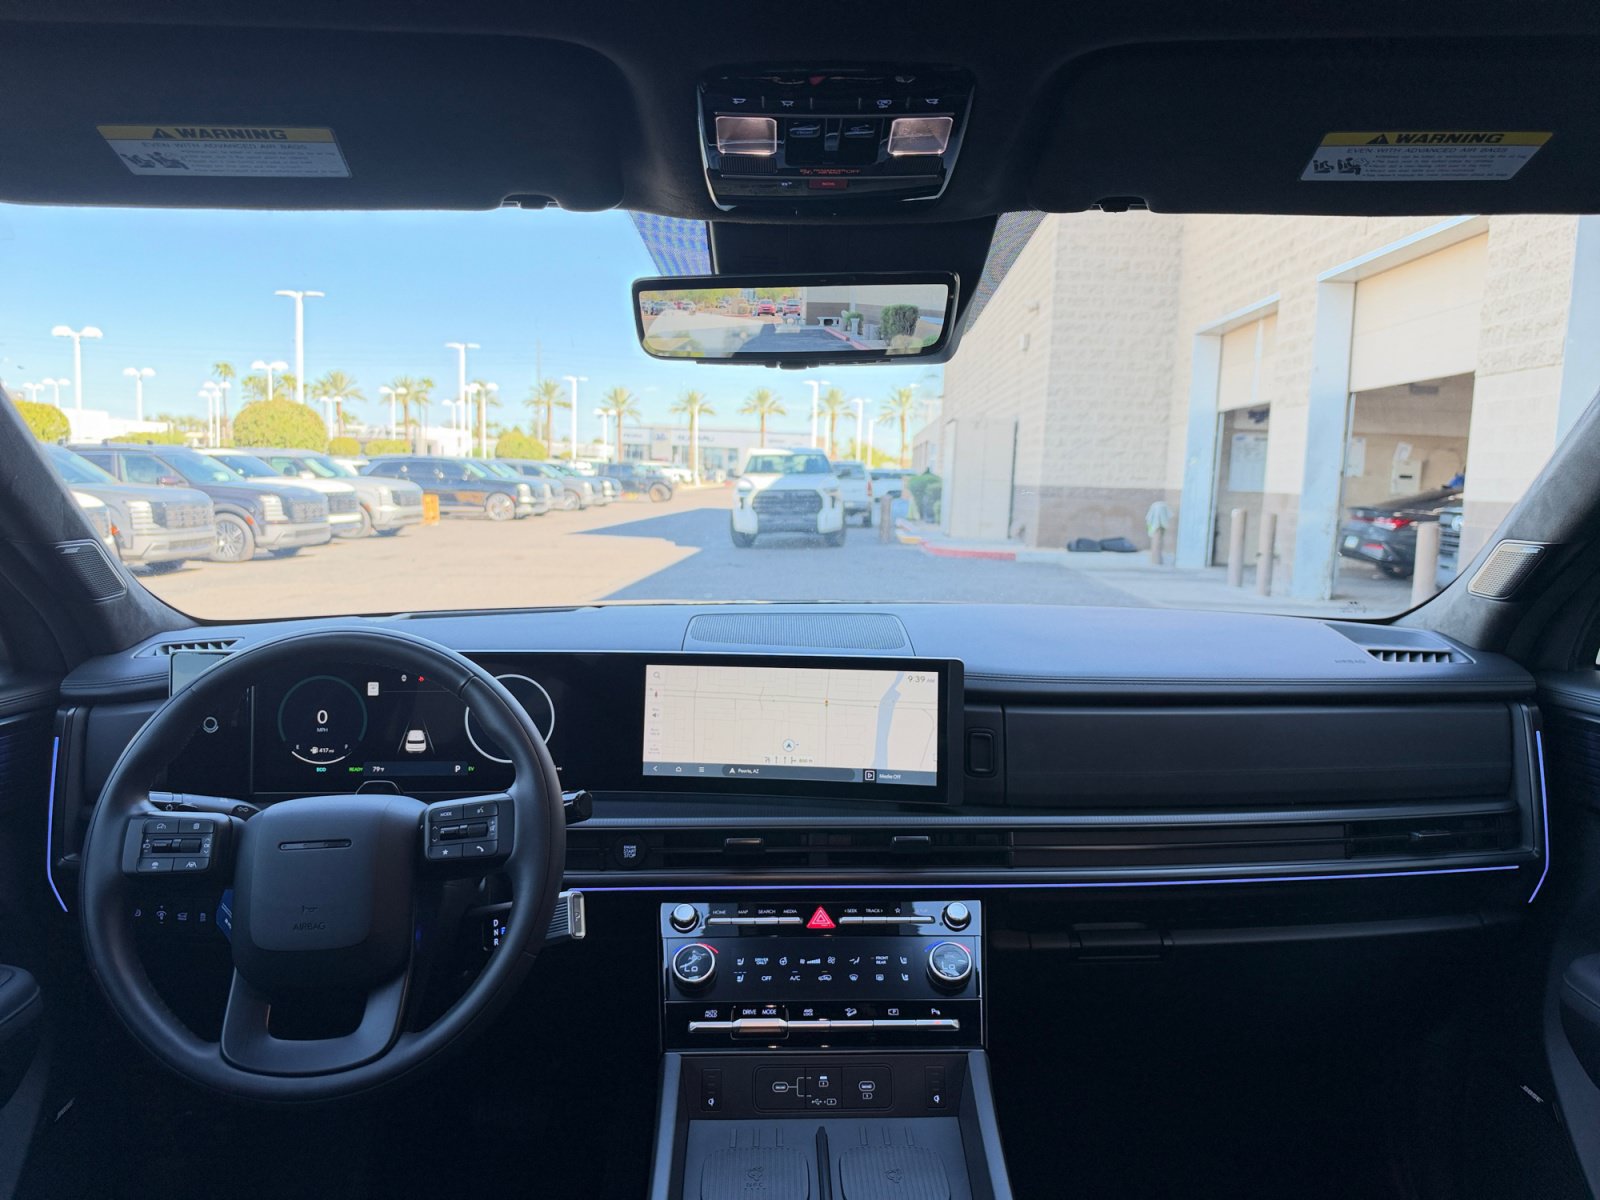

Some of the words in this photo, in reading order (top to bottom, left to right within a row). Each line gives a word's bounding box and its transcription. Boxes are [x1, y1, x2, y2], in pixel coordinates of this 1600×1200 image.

[175, 128, 288, 140] WARNING
[1395, 133, 1505, 144] WARNING
[317, 709, 329, 724] 0
[455, 764, 461, 773] P
[292, 922, 326, 930] AIRBAG
[493, 919, 499, 927] D
[493, 929, 499, 937] N
[493, 938, 500, 946] R
